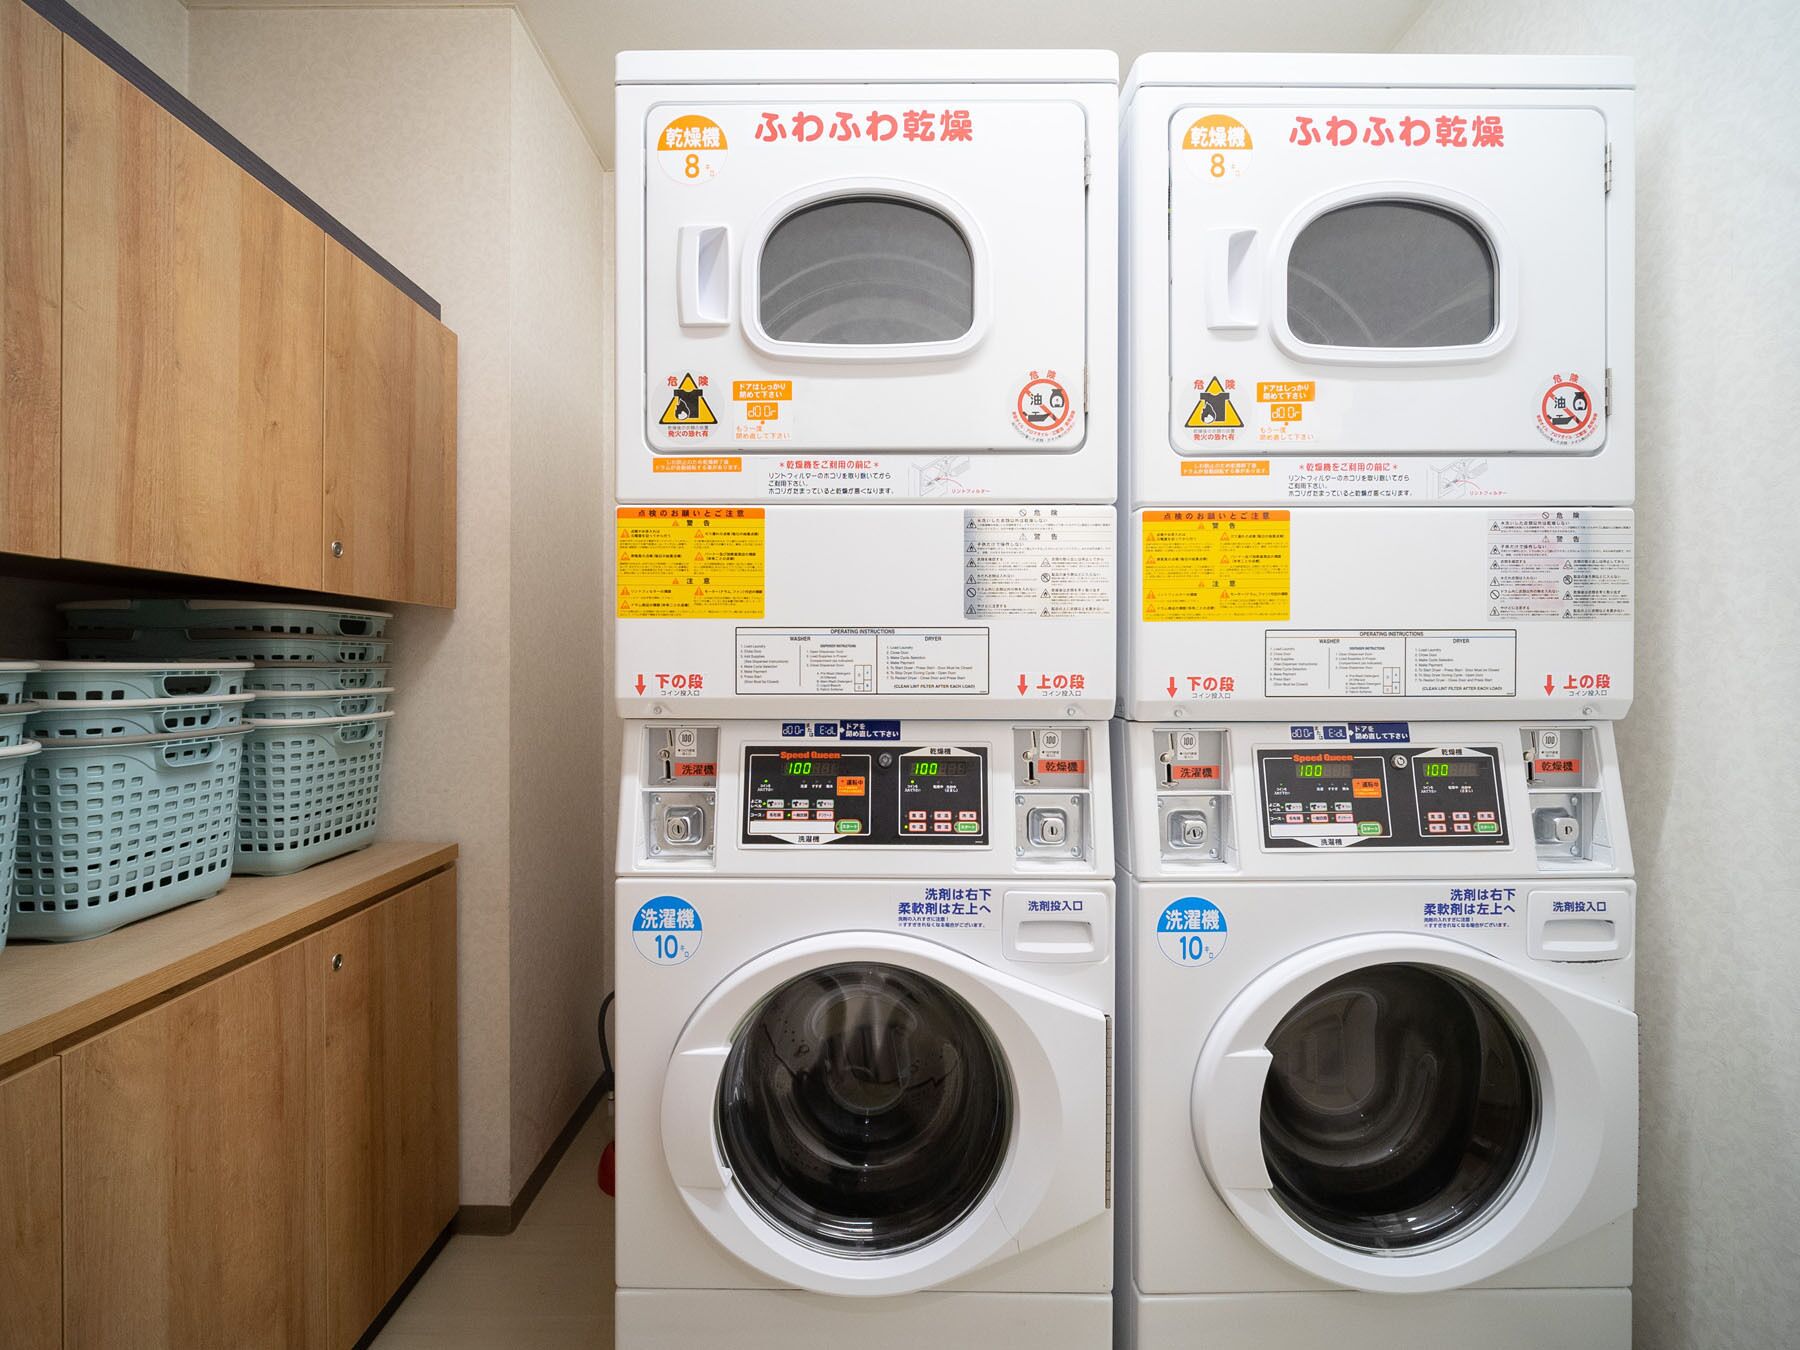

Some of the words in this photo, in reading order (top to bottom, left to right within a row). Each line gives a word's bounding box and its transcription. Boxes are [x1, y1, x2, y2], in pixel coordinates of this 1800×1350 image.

[755, 110, 973, 142] ふわふわ乾燥
[1289, 115, 1504, 148] ふわふわ乾燥
[666, 127, 721, 148] 乾燥機
[1190, 126, 1245, 148] 乾燥機
[685, 154, 699, 178] 8
[1210, 153, 1225, 178] 8
[739, 383, 786, 391] ドアはしっかり
[1263, 384, 1308, 392] ドアはしっかり
[1031, 393, 1042, 405] 油
[1555, 396, 1566, 408] 油
[1164, 512, 1270, 520] 点検のお願いとご注意
[655, 674, 703, 689] 下の段
[1036, 674, 1084, 689] 上の段
[1187, 677, 1234, 691] 下の段
[1563, 674, 1610, 689] 上の段
[682, 734, 692, 742] 100
[1046, 736, 1056, 744] 100
[1184, 737, 1193, 745] 100
[1545, 736, 1555, 744] 100
[1292, 754, 1322, 762] Speed
[682, 765, 714, 775] 洗濯機
[788, 762, 812, 775] 100
[915, 763, 938, 775] 100
[1046, 762, 1078, 772] 乾燥機
[1300, 765, 1323, 777] 100
[1426, 764, 1448, 776] 100
[1542, 761, 1573, 771] 乾燥機
[1180, 768, 1212, 778] 洗濯機
[1320, 838, 1342, 846] 洗濯機
[925, 888, 992, 901] 洗剤は右下
[1450, 889, 1516, 901] 洗剤は右下
[898, 902, 991, 915] 柔軟剤は左上へ
[1028, 900, 1083, 912] 洗剤投入口
[1424, 903, 1515, 915] 柔軟剤は左上へ
[1552, 901, 1607, 912] 洗剤投入口
[640, 908, 694, 928] 洗濯機
[1166, 909, 1219, 930] 洗濯機
[655, 934, 678, 958] 10
[1180, 936, 1203, 960] 10
